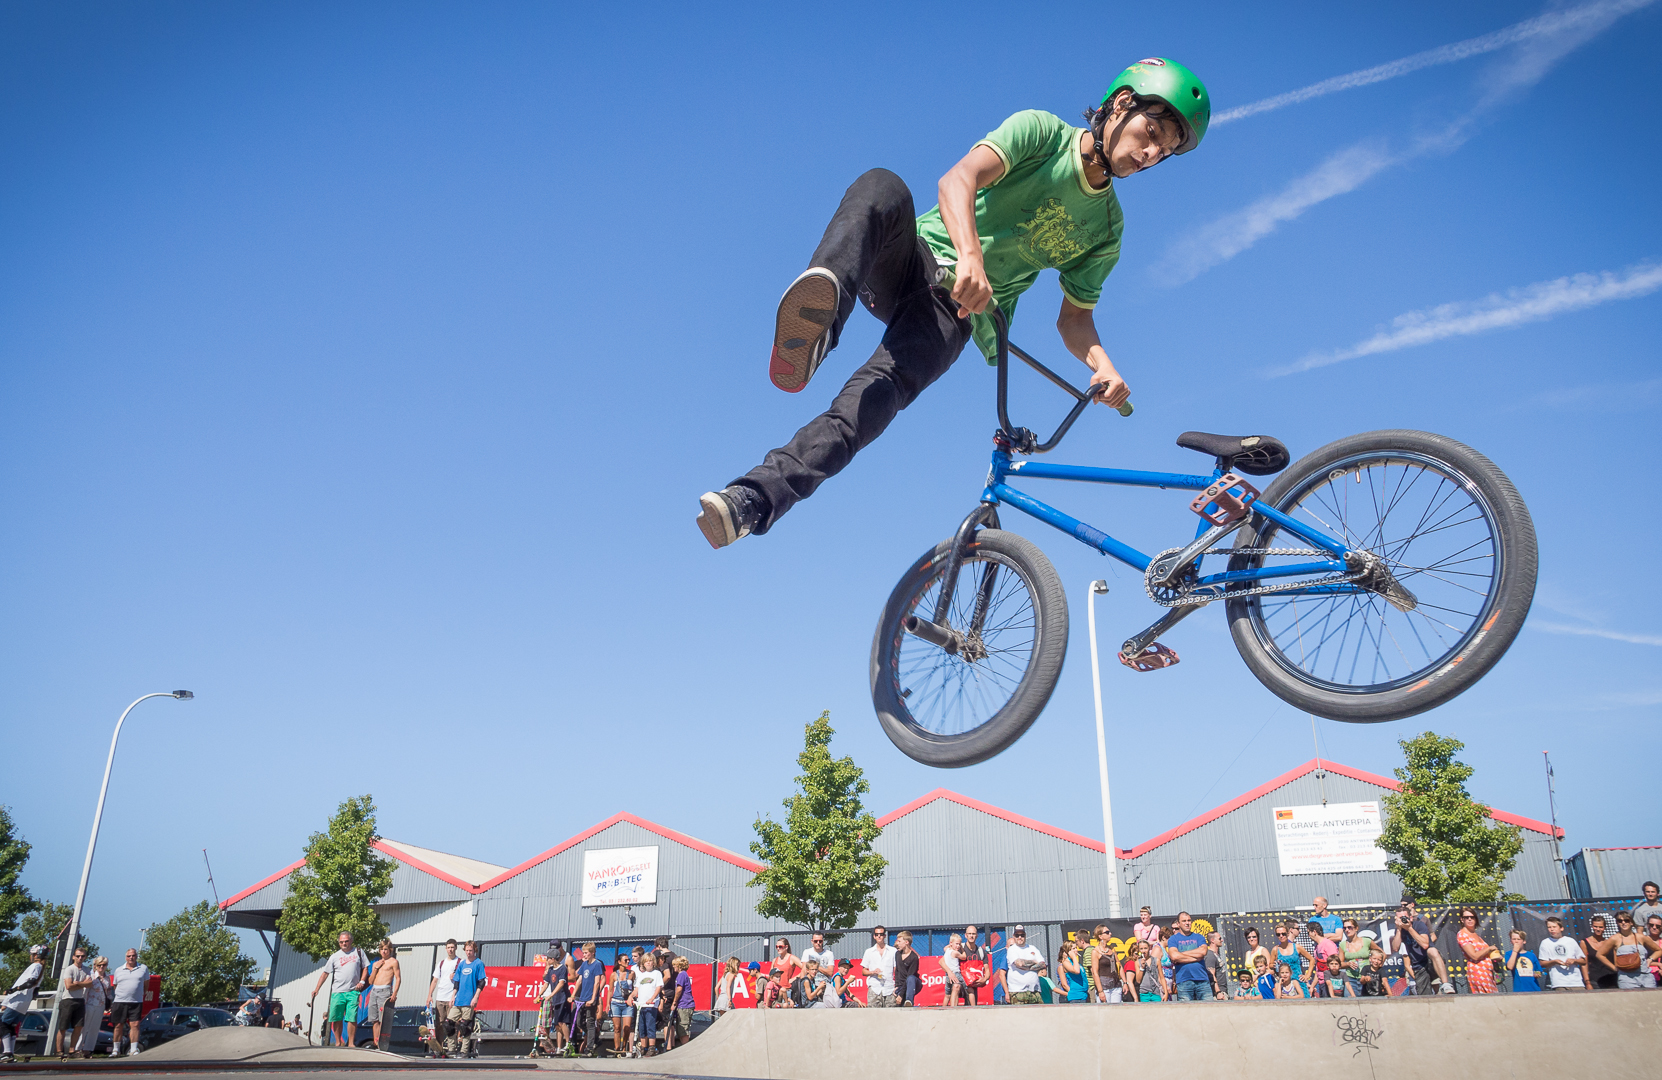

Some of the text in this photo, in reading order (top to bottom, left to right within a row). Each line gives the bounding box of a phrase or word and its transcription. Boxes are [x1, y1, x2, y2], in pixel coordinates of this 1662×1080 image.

[1290, 818, 1371, 829] GRAVE-ANTVERPIA
[506, 981, 522, 998] Er
[732, 973, 750, 999] A
[921, 974, 947, 987] Spor
